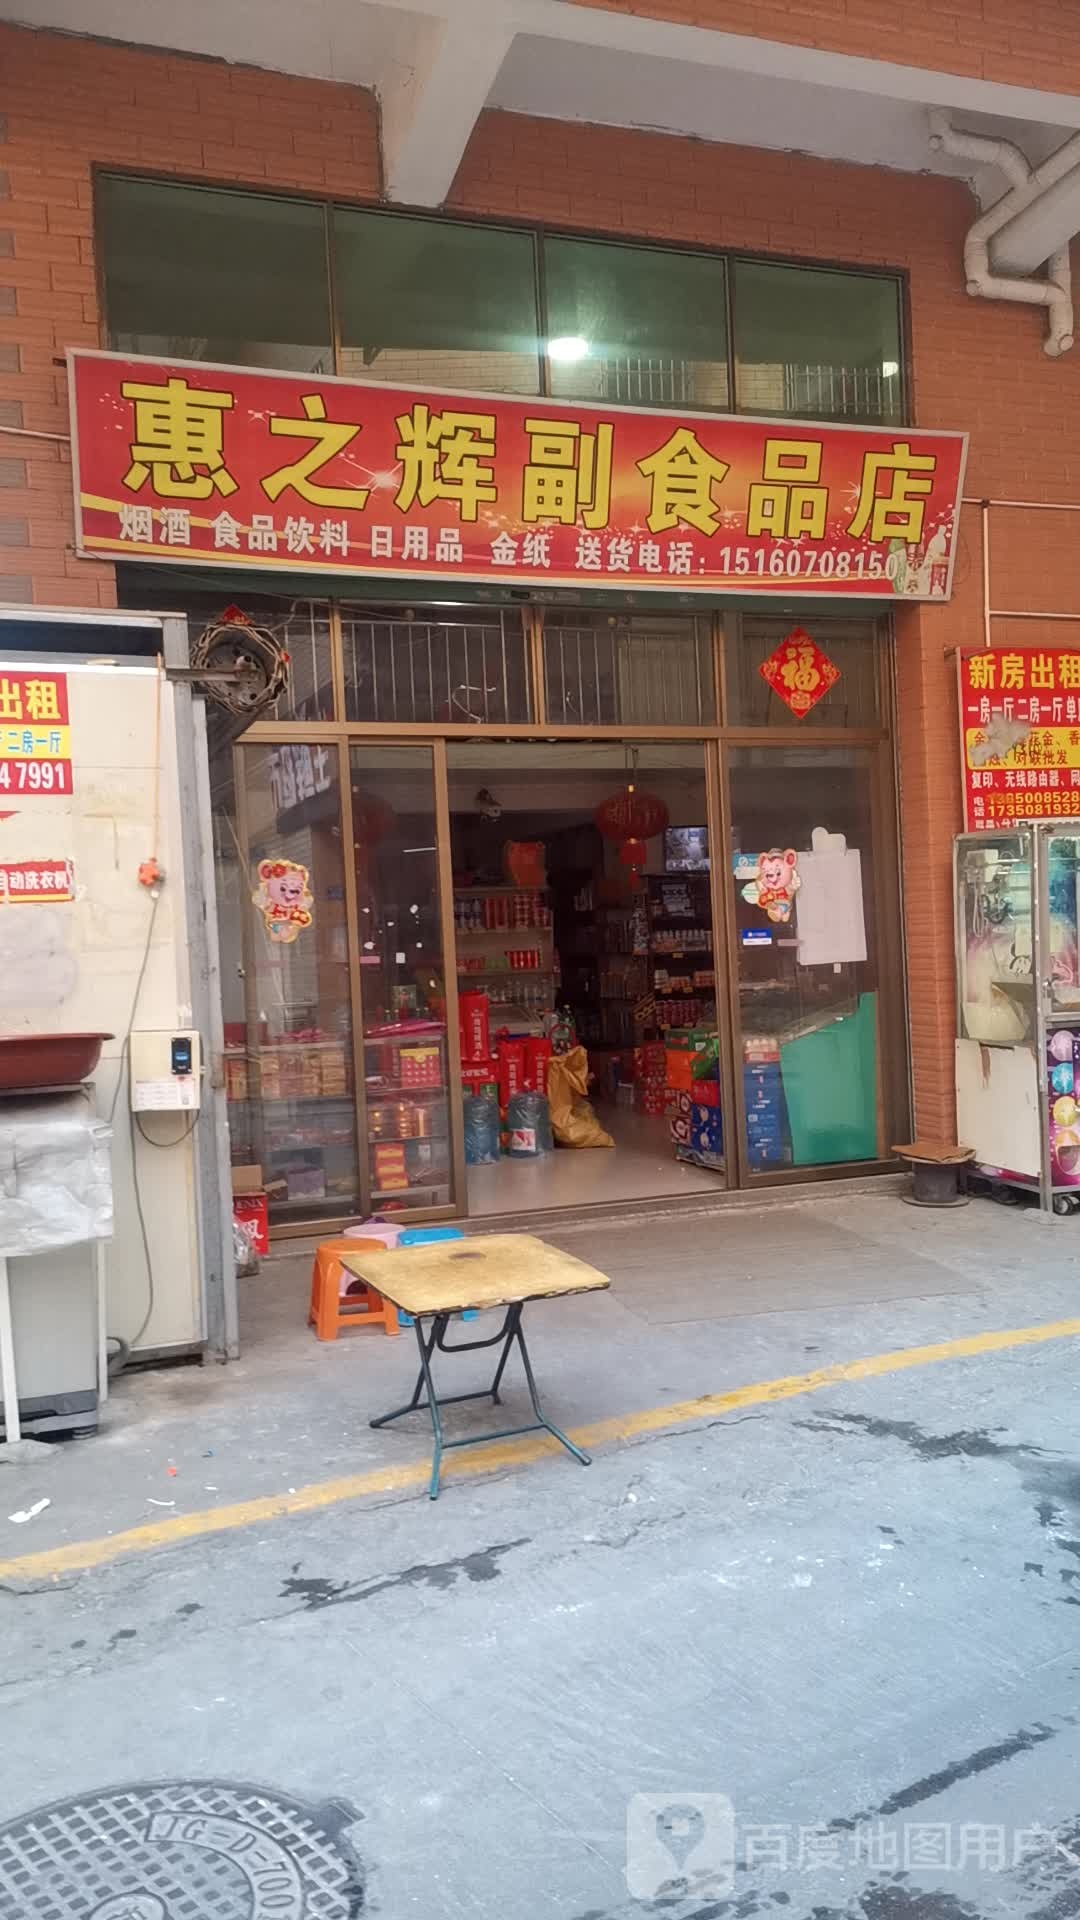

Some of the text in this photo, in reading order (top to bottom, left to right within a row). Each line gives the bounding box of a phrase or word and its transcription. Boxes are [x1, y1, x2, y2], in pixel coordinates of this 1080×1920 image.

[120, 376, 937, 545] 惠之辉副食品店
[118, 504, 191, 546] 烟酒
[209, 511, 350, 557] 食品饮料
[370, 525, 464, 563] 日用品
[490, 531, 551, 568] 金纸
[719, 545, 898, 581] 15160708150
[781, 646, 820, 692] 福
[969, 653, 1080, 689] 新房出租
[0, 678, 61, 721] 出租
[968, 696, 1080, 723] 一房一厅二房一厅单
[0, 729, 61, 753] 二房一厅
[15, 762, 65, 790] 7991
